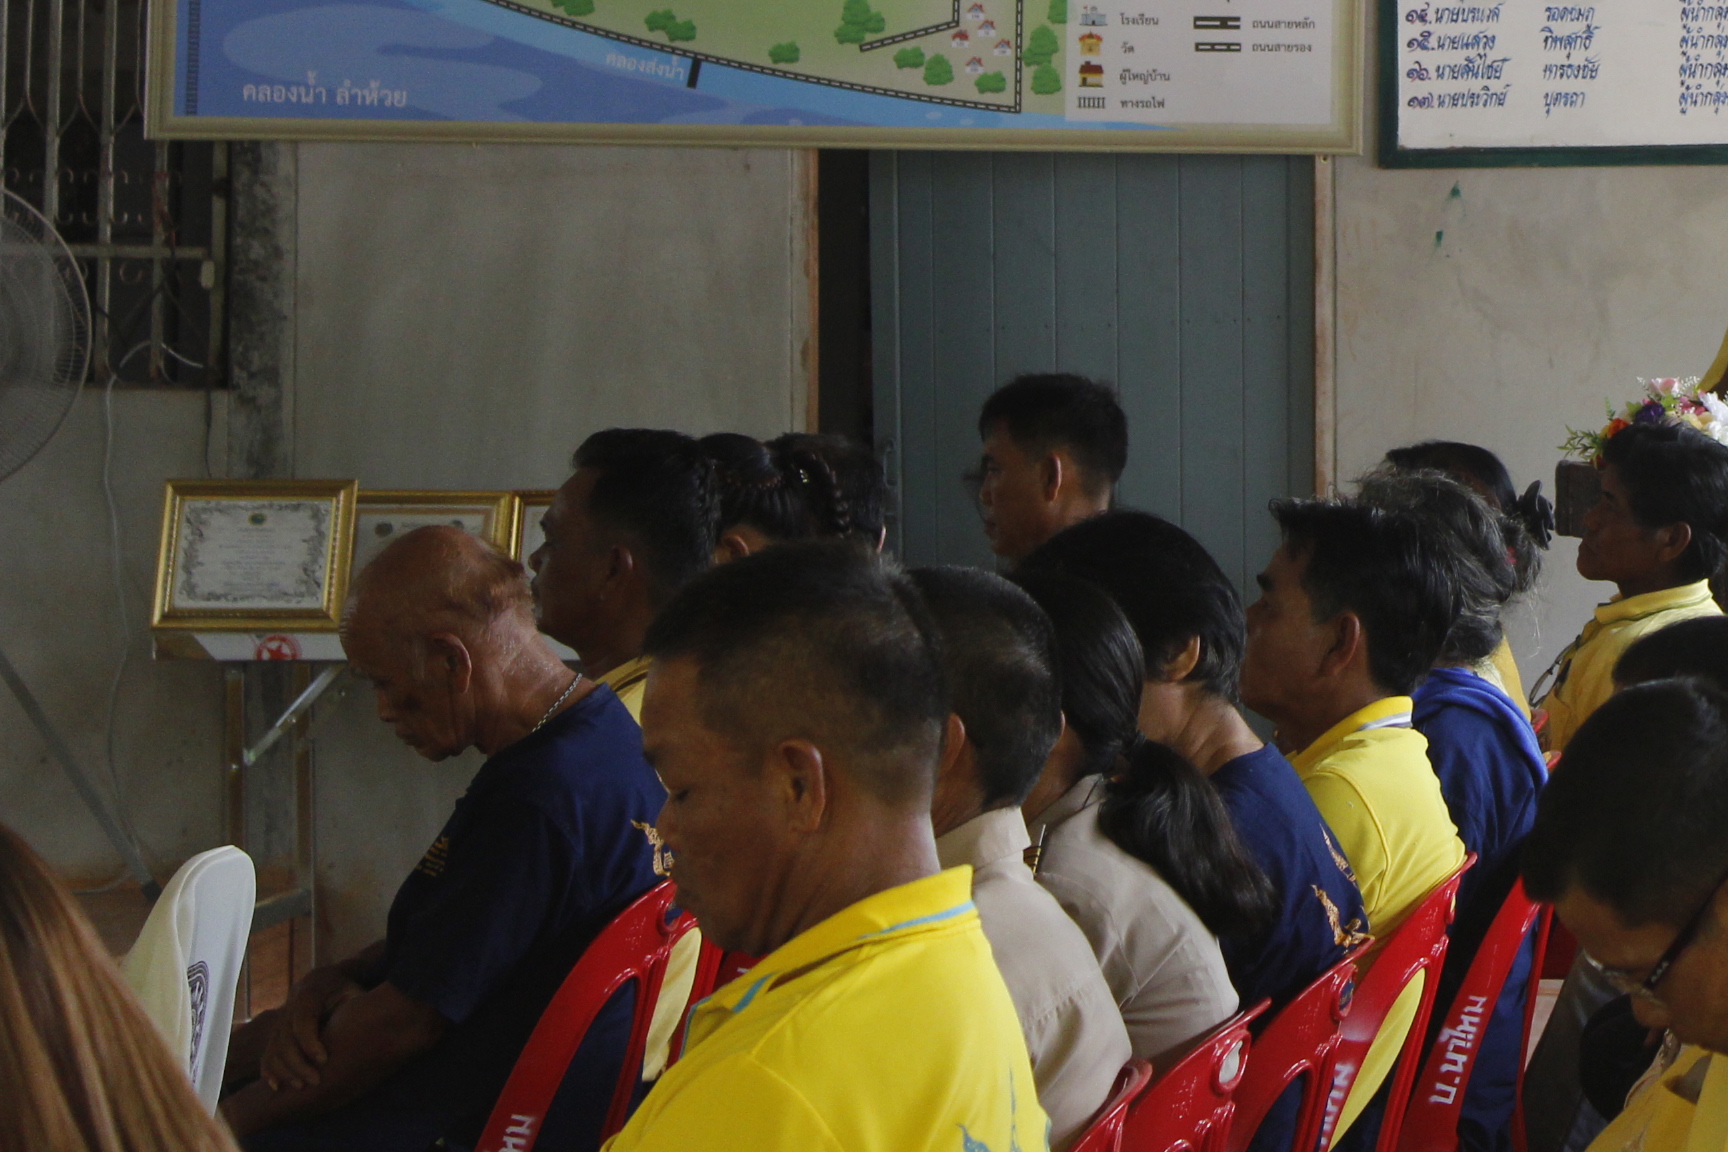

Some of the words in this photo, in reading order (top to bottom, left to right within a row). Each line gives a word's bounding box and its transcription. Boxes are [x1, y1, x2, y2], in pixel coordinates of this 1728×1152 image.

[243, 70, 327, 105] คลองน้ำ
[336, 79, 407, 109] ลำห้วย
[1427, 995, 1488, 1105] บ.นาไหม
